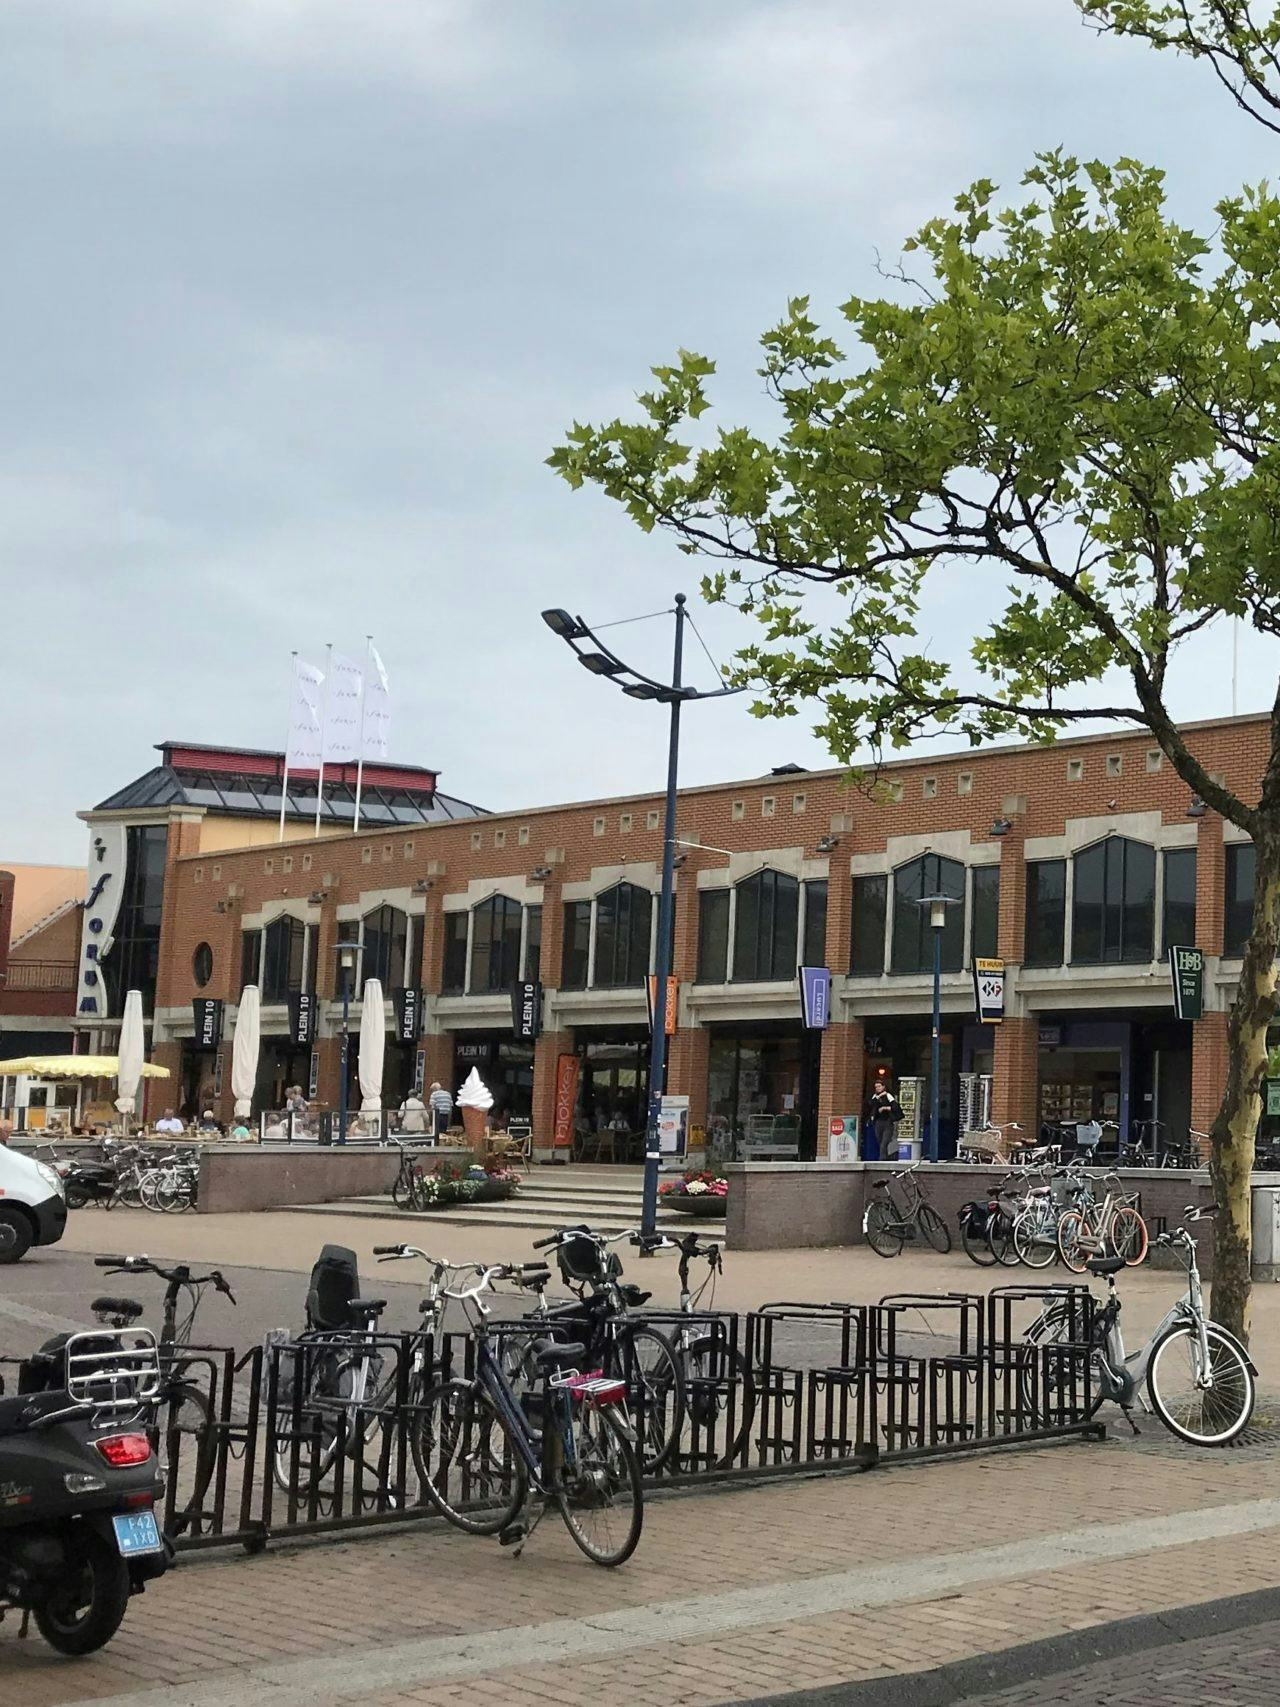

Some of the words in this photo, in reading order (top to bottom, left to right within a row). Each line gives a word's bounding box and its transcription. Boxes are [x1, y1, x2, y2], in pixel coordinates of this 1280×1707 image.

[1179, 951, 1202, 971] H&B
[405, 990, 415, 1004] 10
[524, 984, 534, 998] 10
[205, 1000, 215, 1013] 10
[300, 996, 309, 1009] 10
[404, 1006, 414, 1038] PLEIN
[522, 1001, 532, 1035] PLEIN
[203, 1015, 213, 1044] PLEIN
[298, 1011, 309, 1041] PLEIN
[457, 1045, 478, 1057] PLEIN
[478, 1044, 487, 1056] 10
[556, 1065, 574, 1138] blokker
[128, 1515, 153, 1530] F42
[133, 1531, 156, 1546] 1XD
